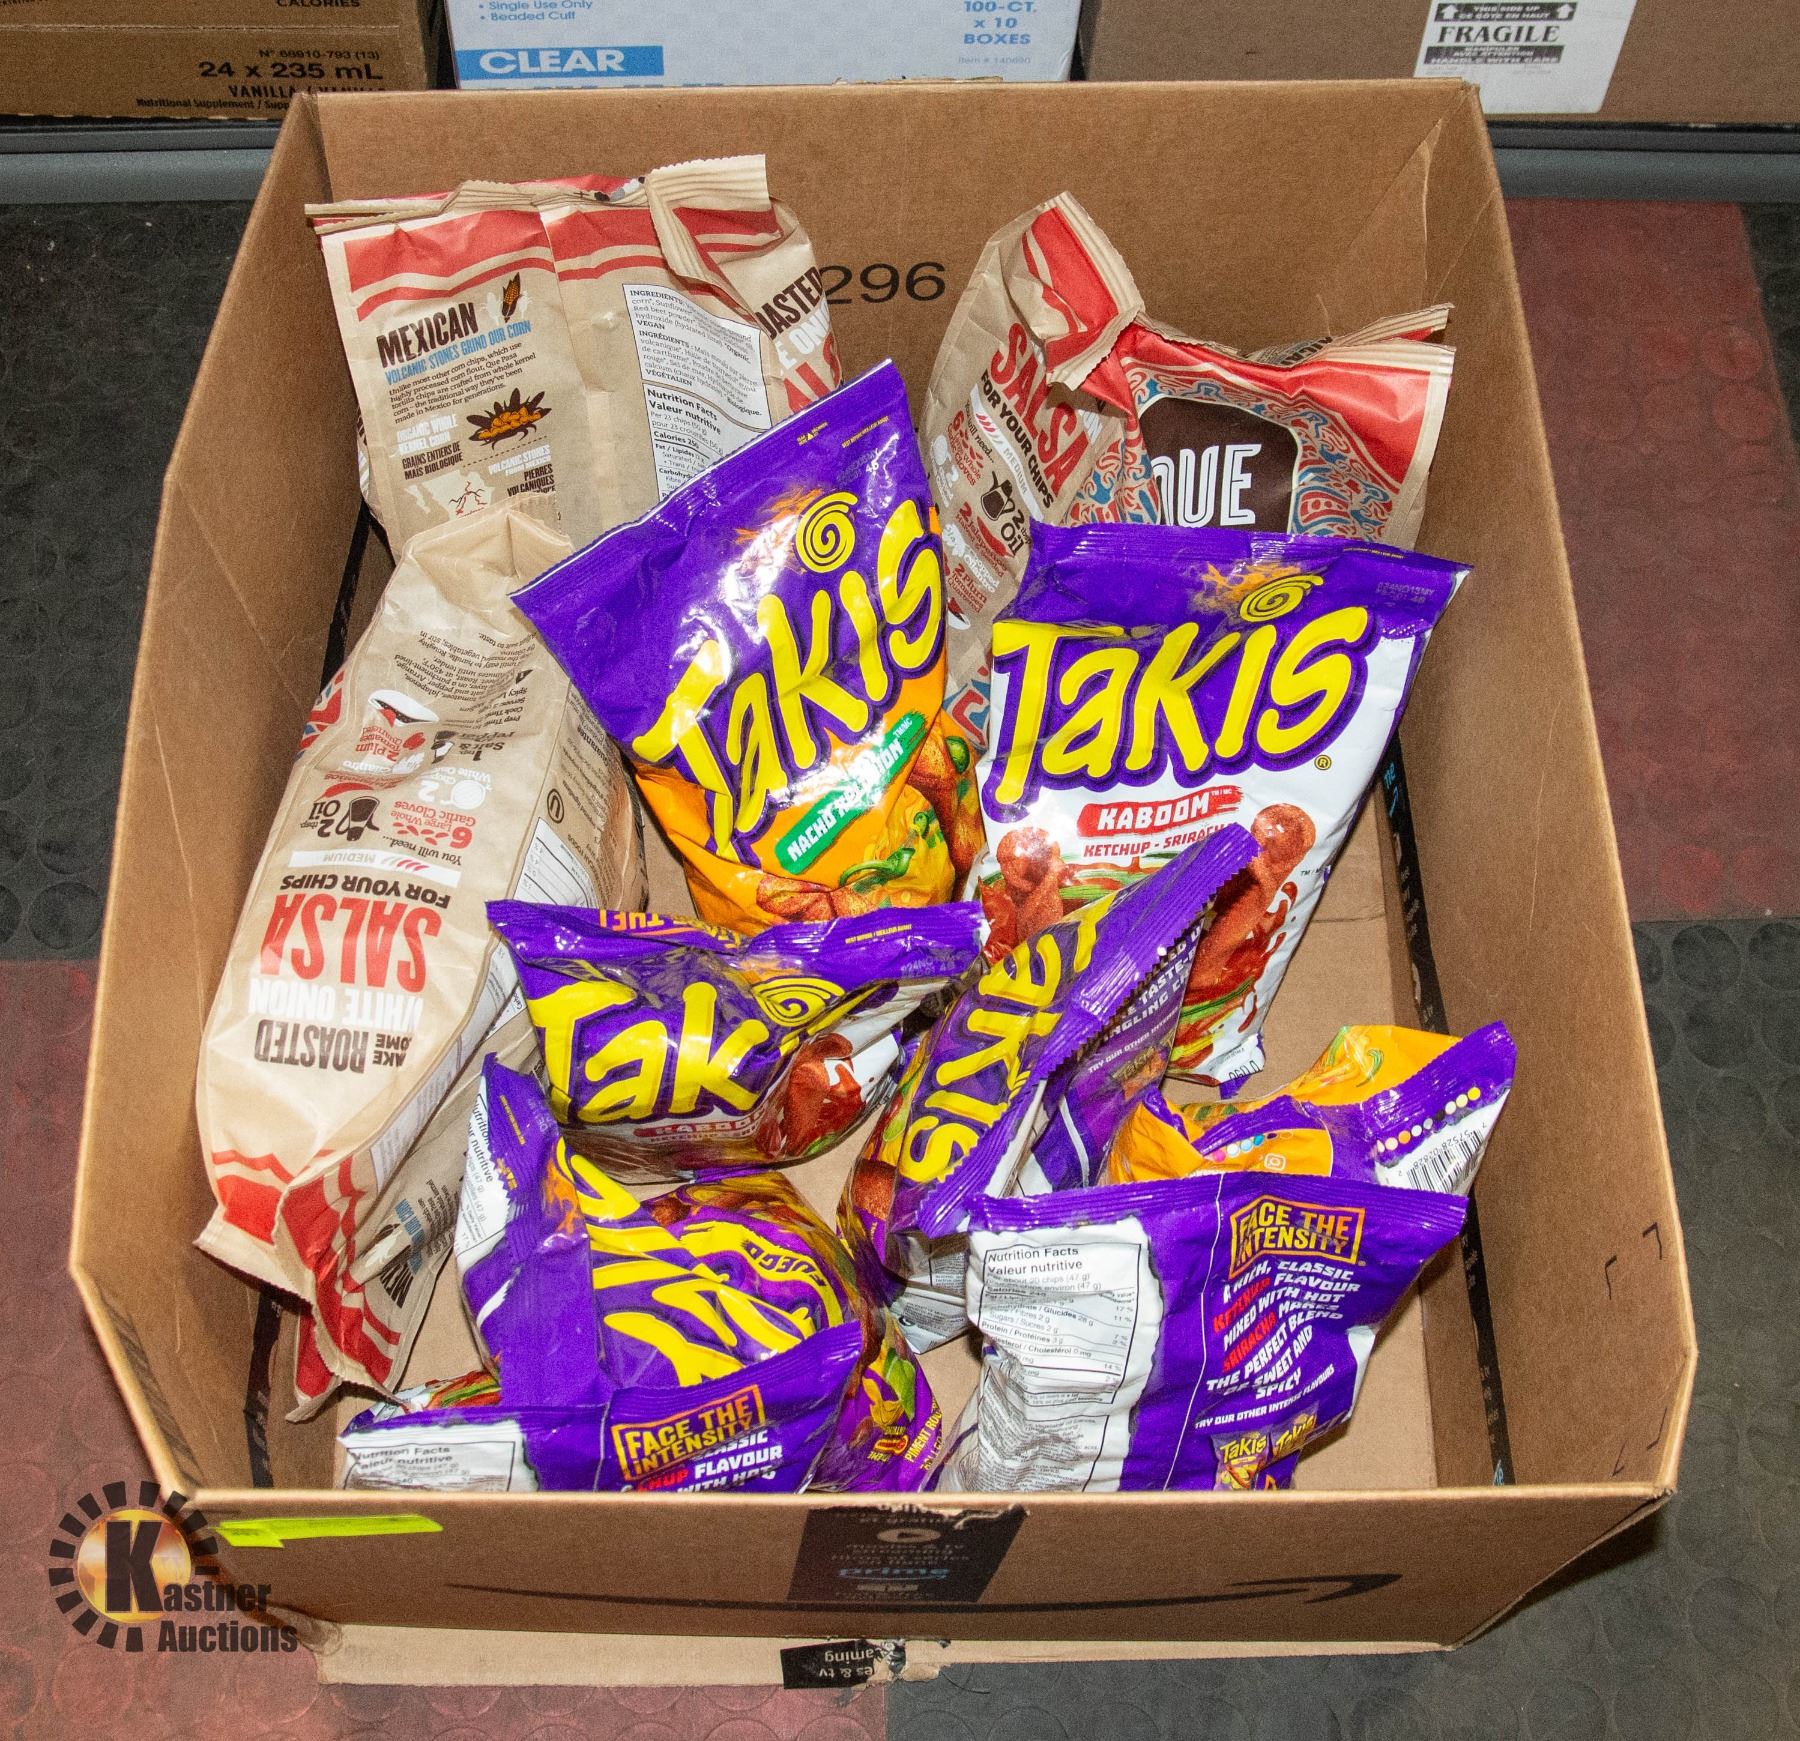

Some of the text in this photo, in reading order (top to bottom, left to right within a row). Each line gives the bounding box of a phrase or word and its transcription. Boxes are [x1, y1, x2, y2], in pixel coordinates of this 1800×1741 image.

[491, 11, 576, 21] Beaded Cuff
[995, 18, 1018, 28] 10
[964, 33, 1031, 45] BOXES
[1438, 25, 1561, 43] FRAGILE
[199, 61, 383, 80] 24 x 235 mL
[479, 50, 626, 74] CLEAR
[376, 302, 479, 369] MEXICAN
[384, 319, 533, 385] VOLCANIC STONES GRIND OUR CORN
[647, 388, 718, 421] Nutrition Facts
[648, 399, 721, 435] Valeur nutritive
[991, 322, 1089, 498] SALSA
[653, 430, 686, 443] Calories
[981, 369, 1055, 509] FOR YOUR CHIPS
[402, 440, 461, 470] GRAINS ENTIERS DE
[424, 452, 464, 475] BIOLOGIQUE
[506, 474, 555, 497] VOLCANIQUES
[524, 463, 553, 481] PIERRES
[959, 501, 973, 520] 2
[1012, 509, 1025, 531] 2
[1001, 522, 1025, 555] Oil
[954, 562, 988, 605] 2 Plum
[632, 499, 942, 866] Takis
[992, 606, 1369, 804] Takis
[387, 750, 400, 762] 2
[418, 780, 441, 800] 2
[308, 799, 341, 821] Oil
[390, 810, 423, 827] Whole
[393, 801, 477, 828] Garlic Cloves
[1097, 794, 1210, 831] KABOOM
[317, 818, 335, 838] 2
[450, 826, 474, 849] 6
[323, 852, 376, 864] MEDIUM
[382, 834, 463, 867] You will need...
[1083, 839, 1151, 858] KETCHUP
[279, 873, 452, 910] FOR YOUR CHIPS
[259, 892, 443, 993] SALSA
[247, 978, 425, 1032] WHITE ONION
[253, 1018, 370, 1075] ROASTED
[1087, 1030, 1150, 1074] TRY OUR OTHER
[471, 1138, 494, 1183] nutritive
[1238, 1201, 1353, 1242] FACE THE
[987, 1247, 1079, 1264] Nutrition Facts
[1235, 1225, 1349, 1266] INTENSITY
[987, 1259, 1084, 1277] Valeur nutritive
[1223, 1285, 1232, 1304] A
[1277, 1260, 1355, 1282] CLASSIC
[1043, 1305, 1078, 1321] Glucides
[1212, 1273, 1361, 1334] KETCHUP FLAVOUR
[1223, 1286, 1345, 1352] MIXED WITH HOT
[981, 1320, 1051, 1344] Protein Protéines
[1222, 1311, 1277, 1373] SRIRACHA
[1206, 1312, 1344, 1391] THE PERFECT BLEND
[1251, 1346, 1294, 1389] SWEET
[1293, 1324, 1314, 1355] AND
[1195, 1417, 1214, 1430] TRY
[1214, 1413, 1235, 1426] OUR
[1236, 1404, 1268, 1421] OTHER
[1302, 1363, 1336, 1398] FLAVOURS
[1255, 1367, 1303, 1400] SPICY
[624, 1395, 750, 1459] FACE THE
[633, 1412, 752, 1475] INTENSITY
[397, 1455, 453, 1465] nutritive
[415, 1446, 451, 1455] Facts
[904, 1425, 932, 1463] PIMENT
[1219, 1434, 1268, 1464] Takis
[694, 1445, 784, 1480] FLAVOUR
[818, 1667, 835, 1679] tv
[837, 1667, 852, 1679] &
